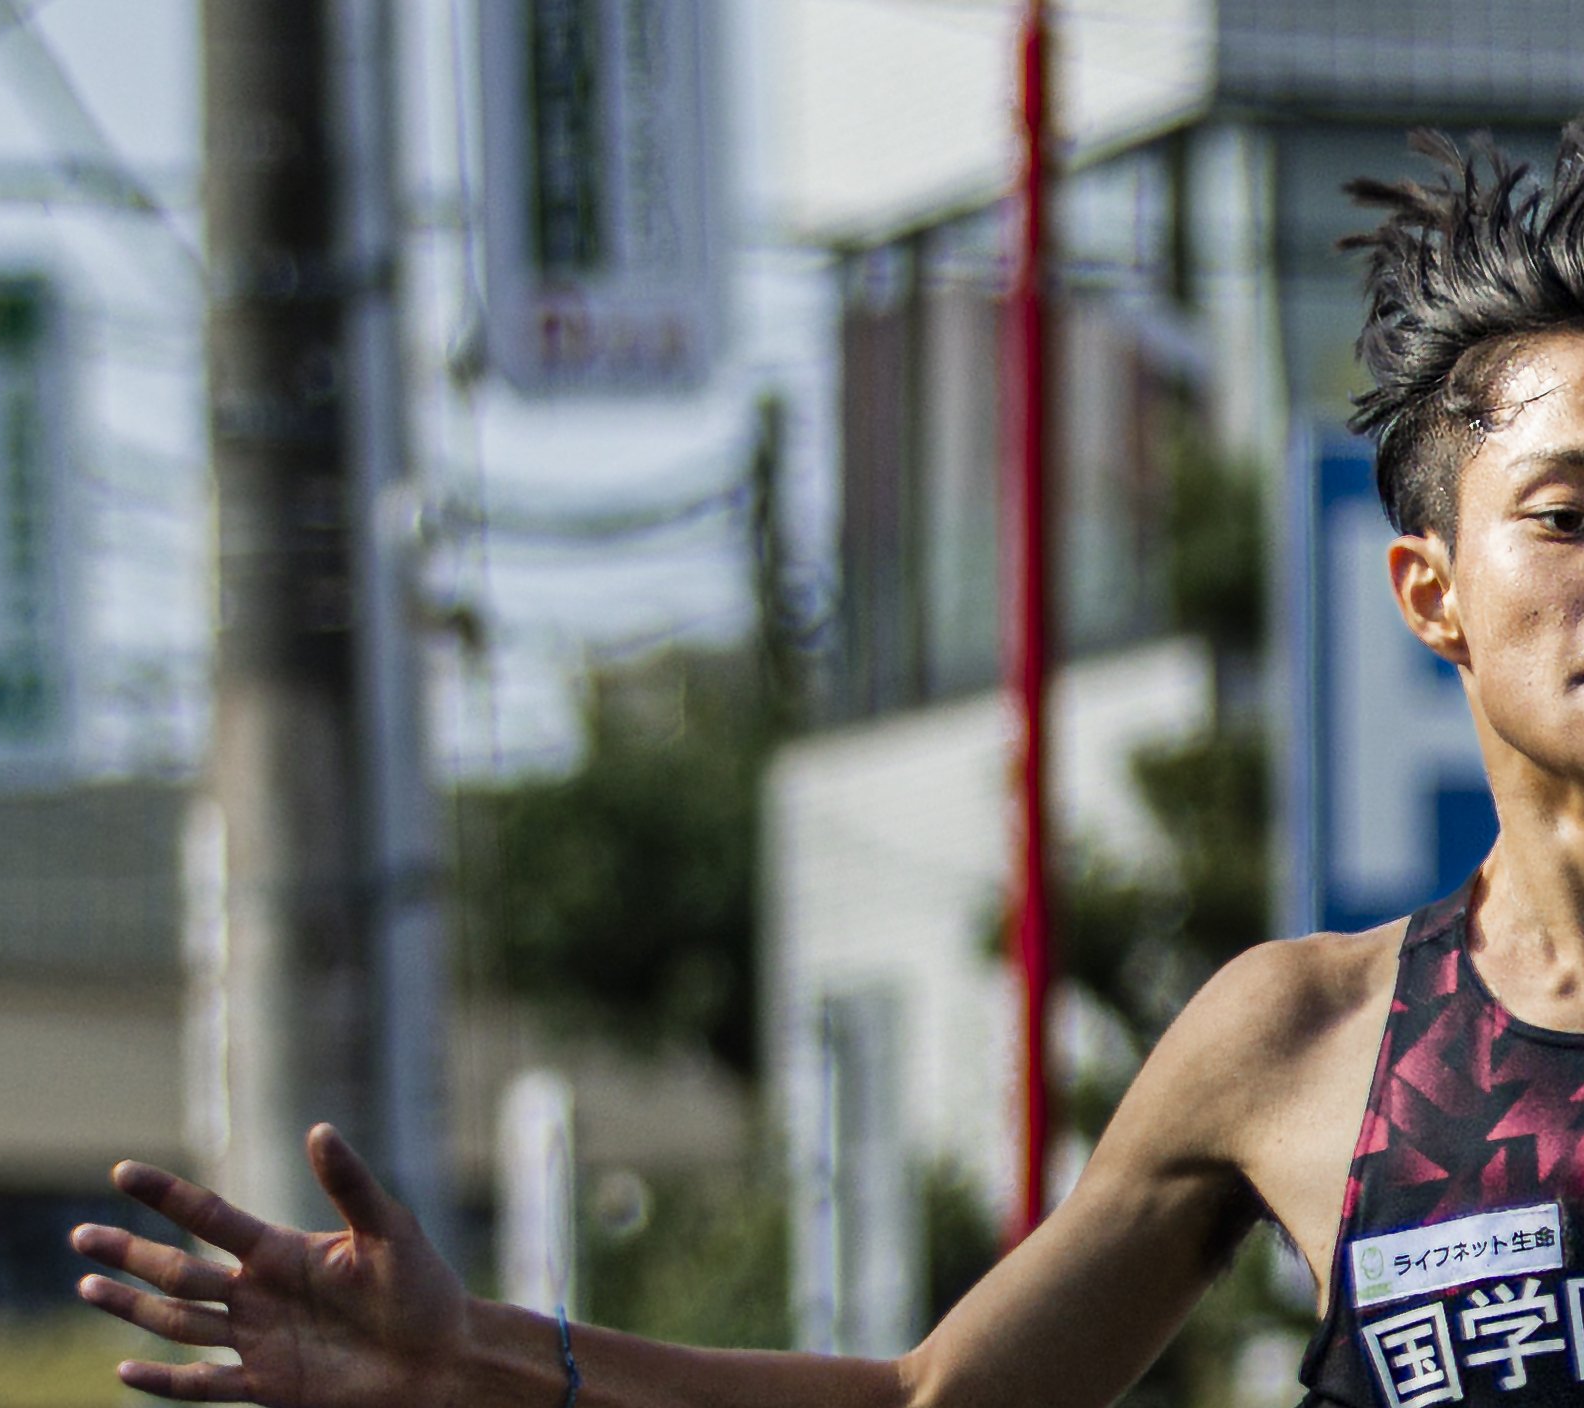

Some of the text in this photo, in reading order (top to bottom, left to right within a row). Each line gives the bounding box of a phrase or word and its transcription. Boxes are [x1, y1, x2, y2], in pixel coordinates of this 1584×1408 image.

[1394, 1226, 1555, 1276] ライフネット生命
